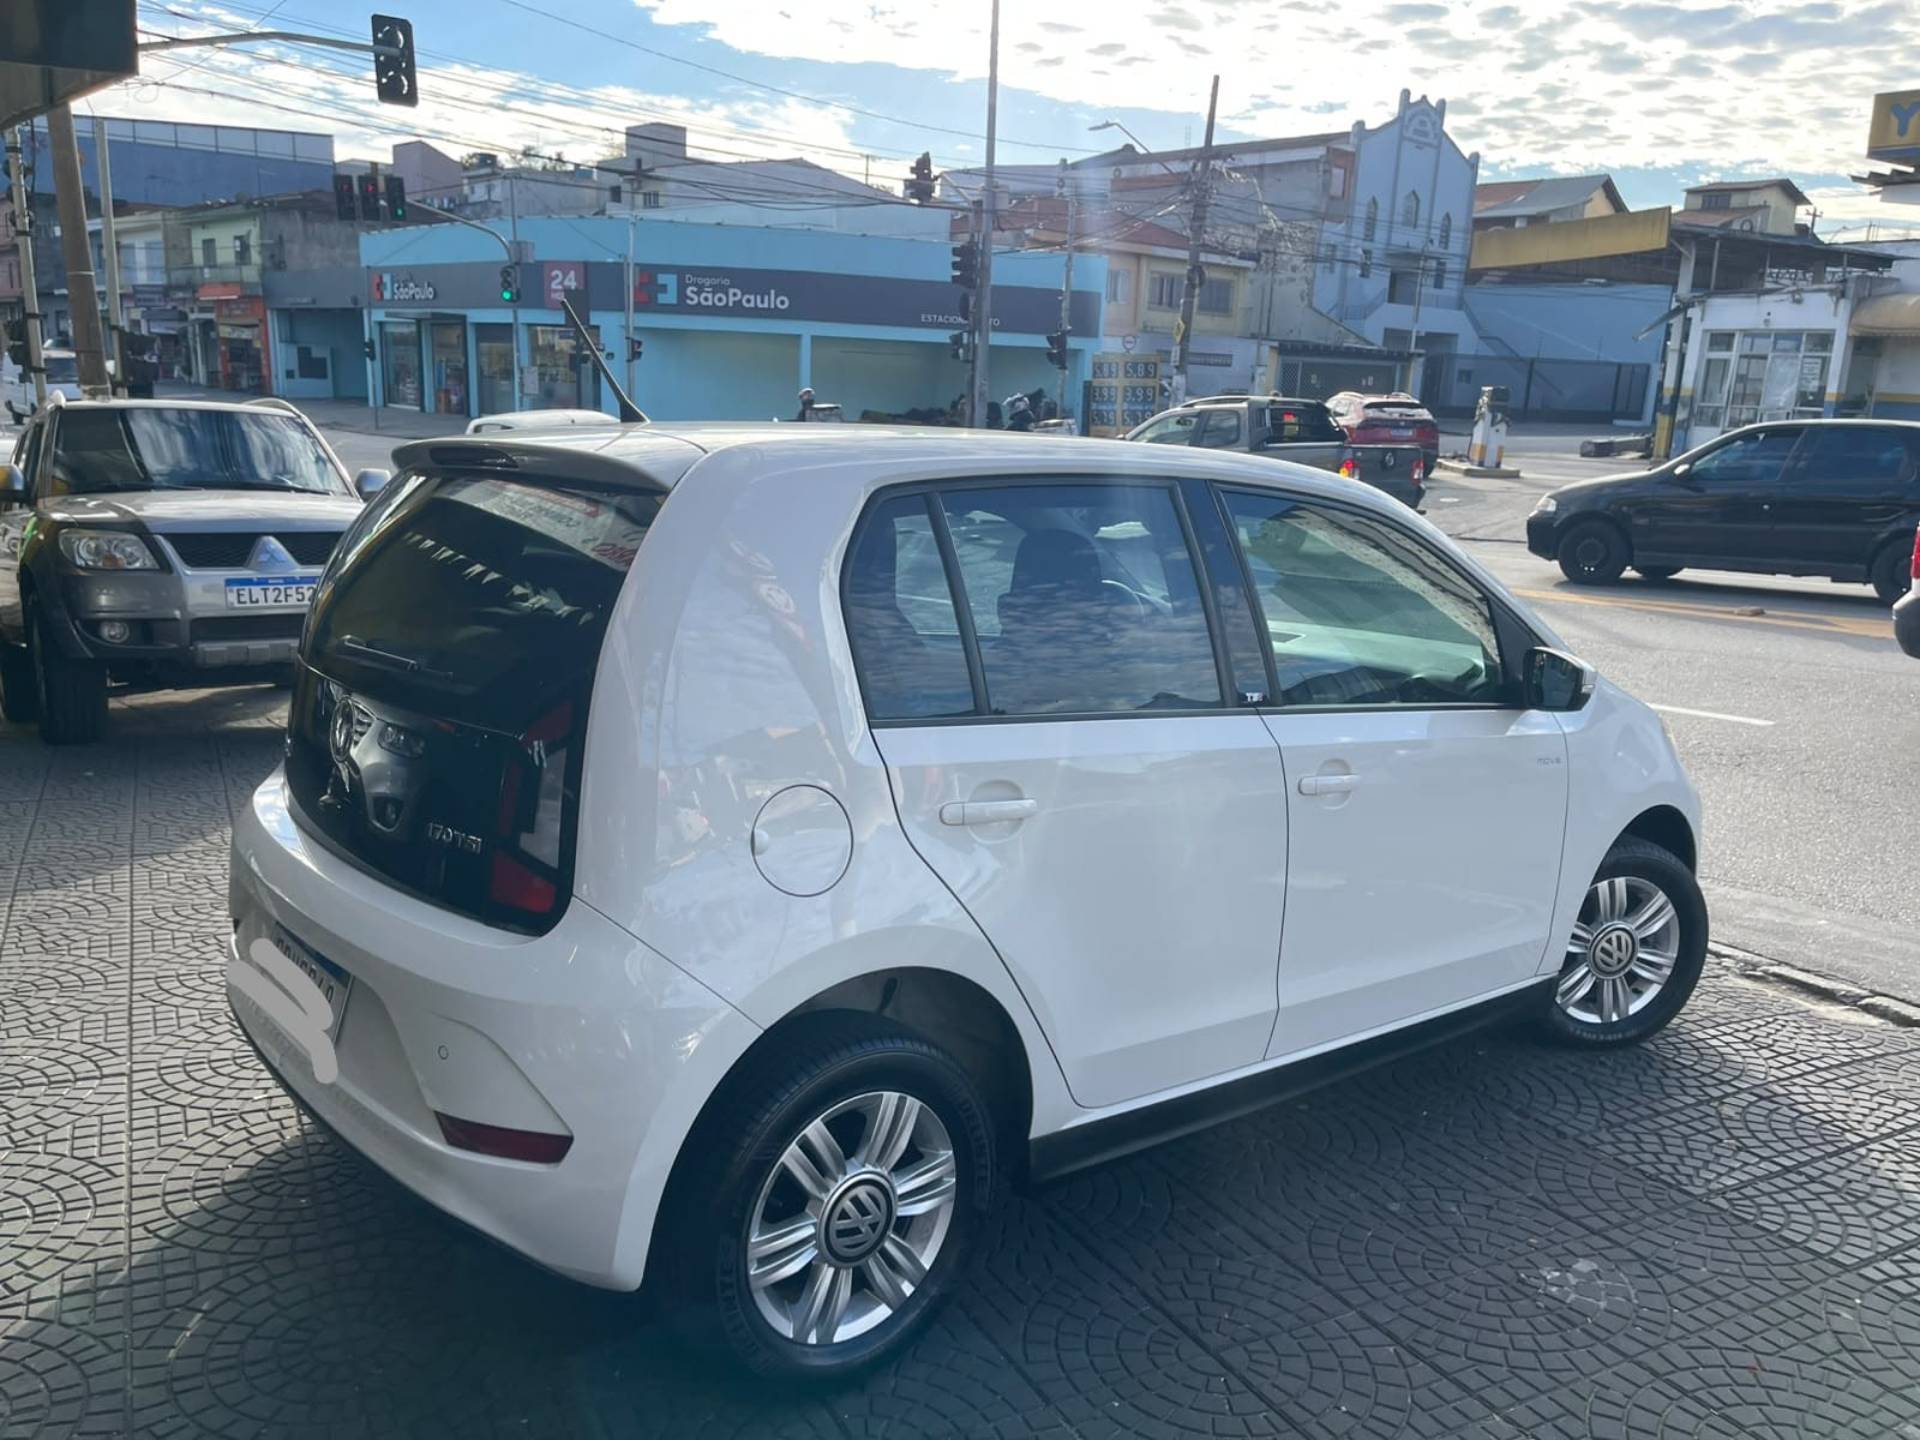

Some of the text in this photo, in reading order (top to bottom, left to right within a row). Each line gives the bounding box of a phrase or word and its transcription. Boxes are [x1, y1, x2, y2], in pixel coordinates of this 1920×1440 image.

[551, 269, 576, 289] 24
[685, 274, 730, 286] Drogaria
[685, 286, 789, 310] SãoPaulo
